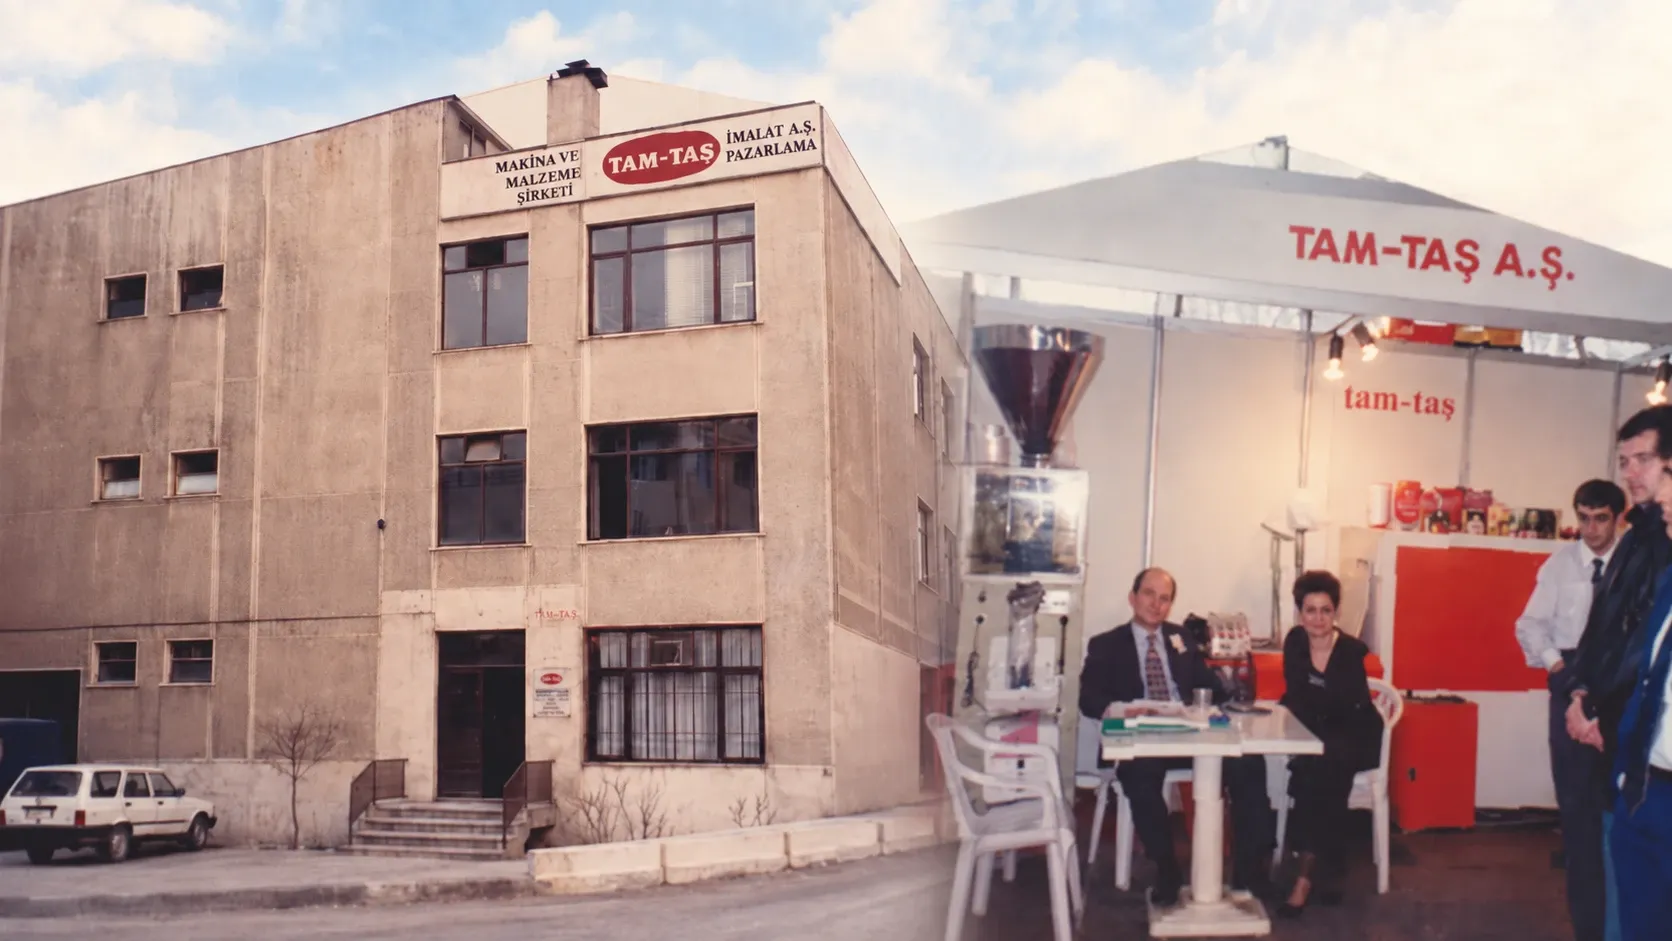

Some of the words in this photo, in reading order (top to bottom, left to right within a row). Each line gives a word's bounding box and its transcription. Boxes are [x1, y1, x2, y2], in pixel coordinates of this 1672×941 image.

[726, 124, 784, 144] İMALAT
[789, 120, 816, 137] A.Ş.
[495, 153, 556, 174] MAKİNA
[559, 149, 579, 163] VE
[608, 143, 715, 174] TAM-TAŞ
[726, 138, 817, 162] PAZARLAMA
[506, 167, 581, 189] MALZEME
[517, 182, 573, 206] ŞİRKETİ
[1289, 224, 1480, 284] TAM-TAŞ
[1493, 242, 1575, 291] A.Ş.
[1344, 385, 1456, 422] tam-taş
